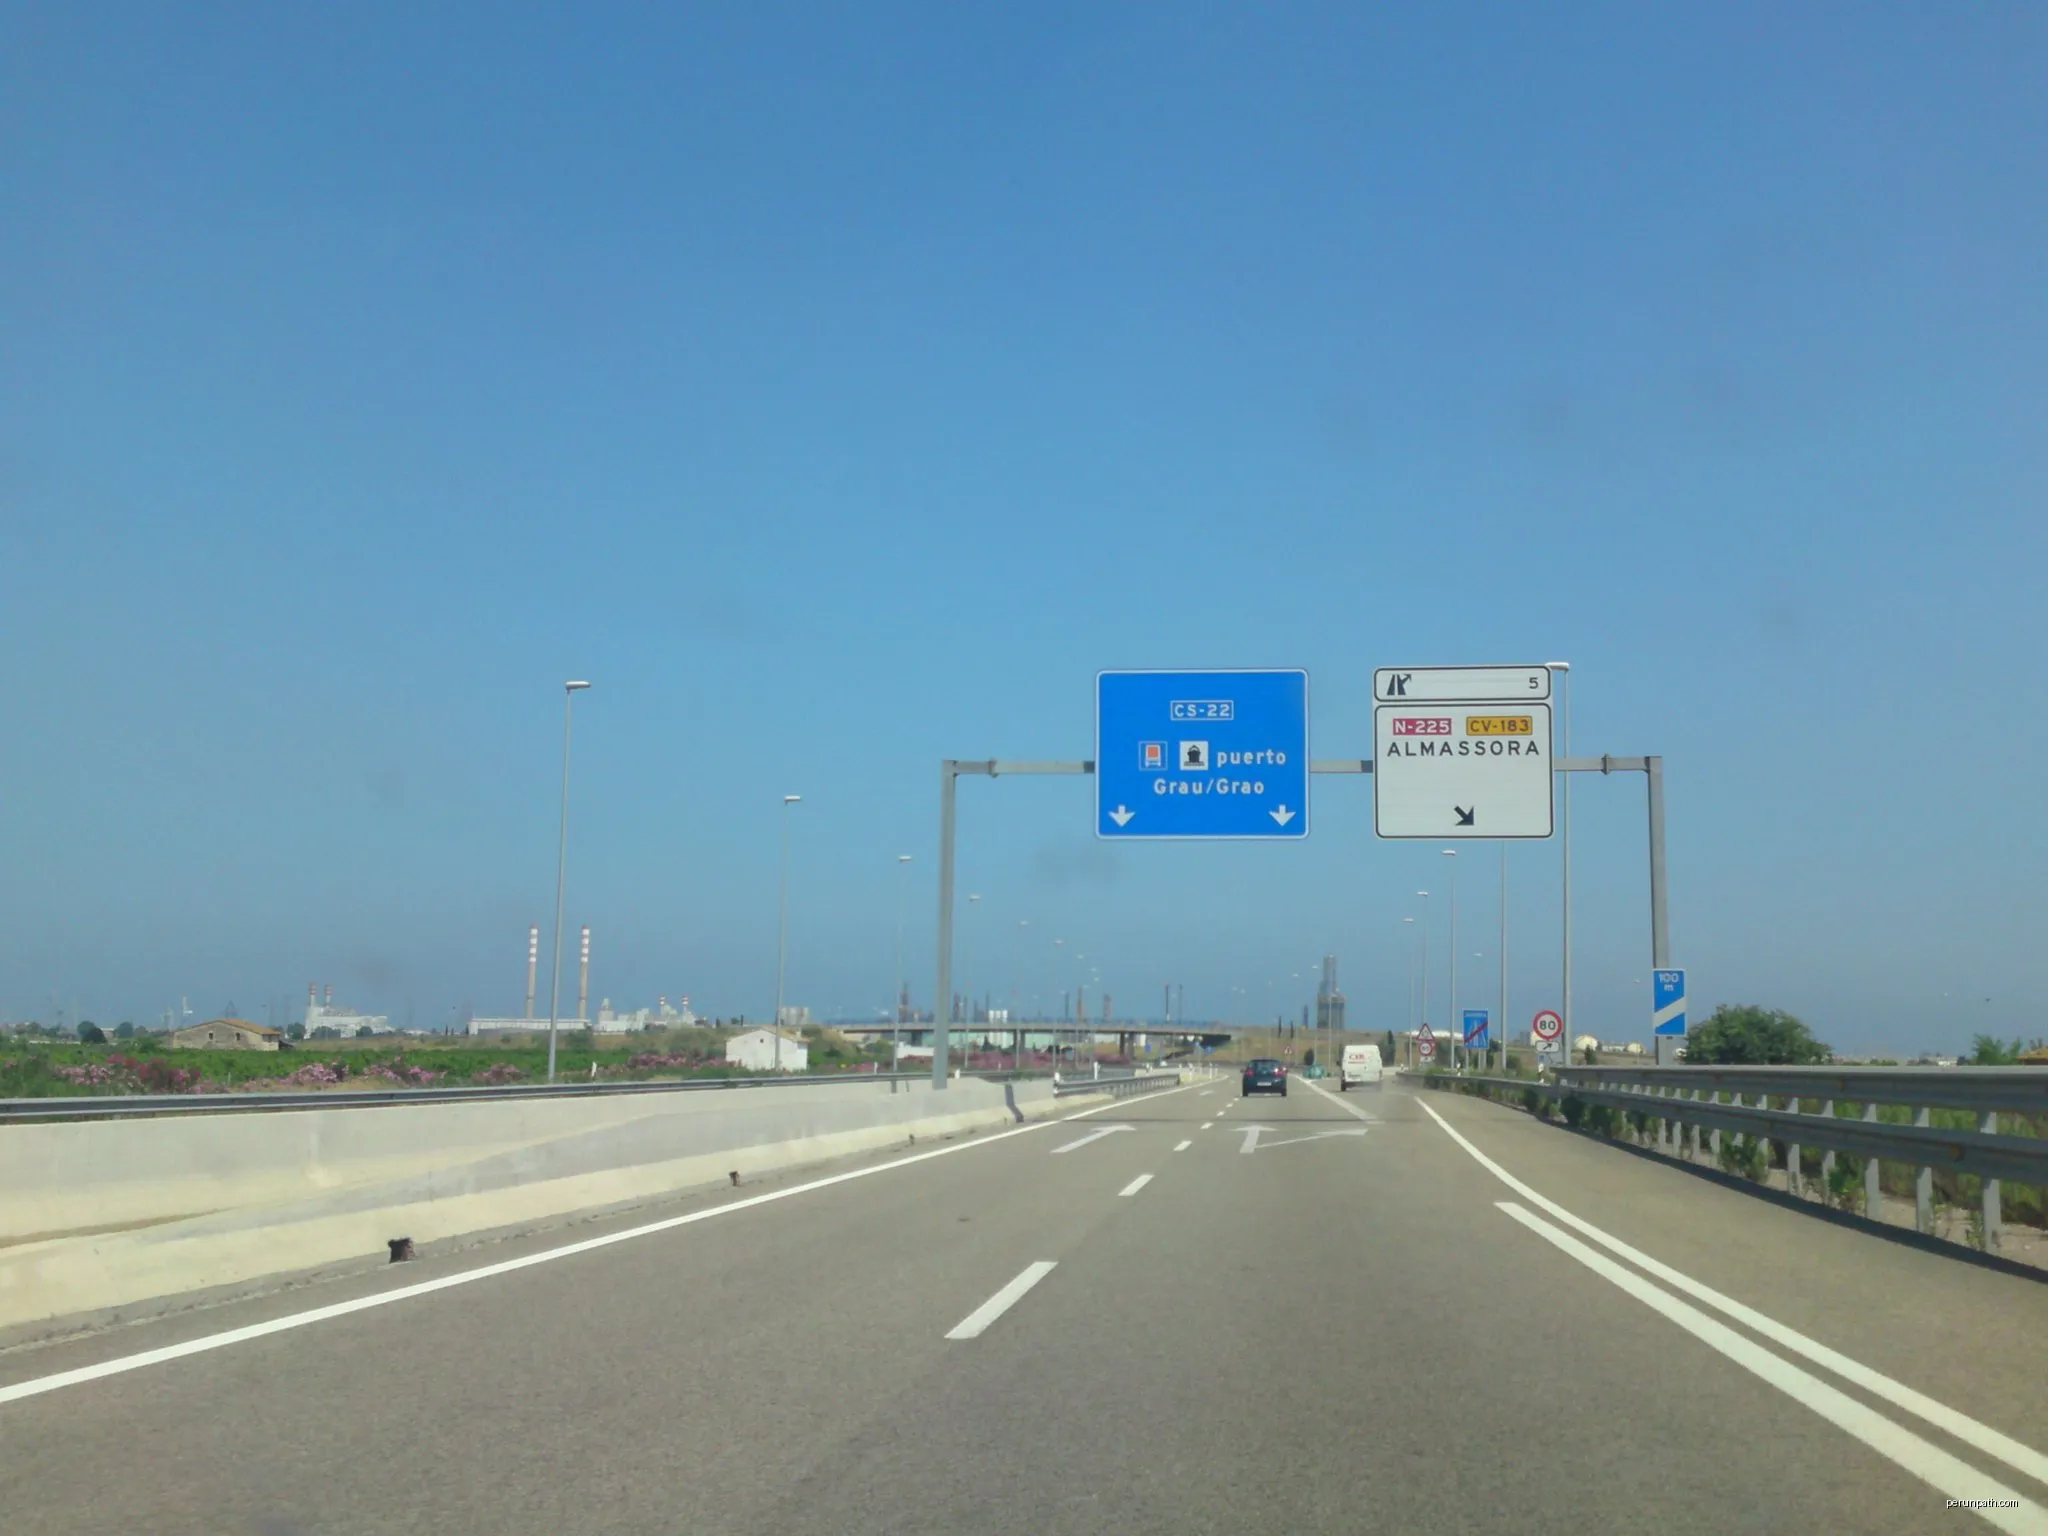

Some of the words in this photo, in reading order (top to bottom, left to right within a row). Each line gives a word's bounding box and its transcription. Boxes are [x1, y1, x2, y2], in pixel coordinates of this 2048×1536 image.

[1529, 677, 1538, 689] 5
[1173, 703, 1231, 718] CS-22
[1394, 719, 1450, 734] N-225
[1469, 718, 1530, 733] CV-183
[1387, 740, 1540, 757] ALMASSORA
[1216, 749, 1287, 769] puerto
[1153, 777, 1265, 796] Grau/Grao
[1658, 973, 1679, 983] 100
[1539, 1020, 1556, 1030] 80
